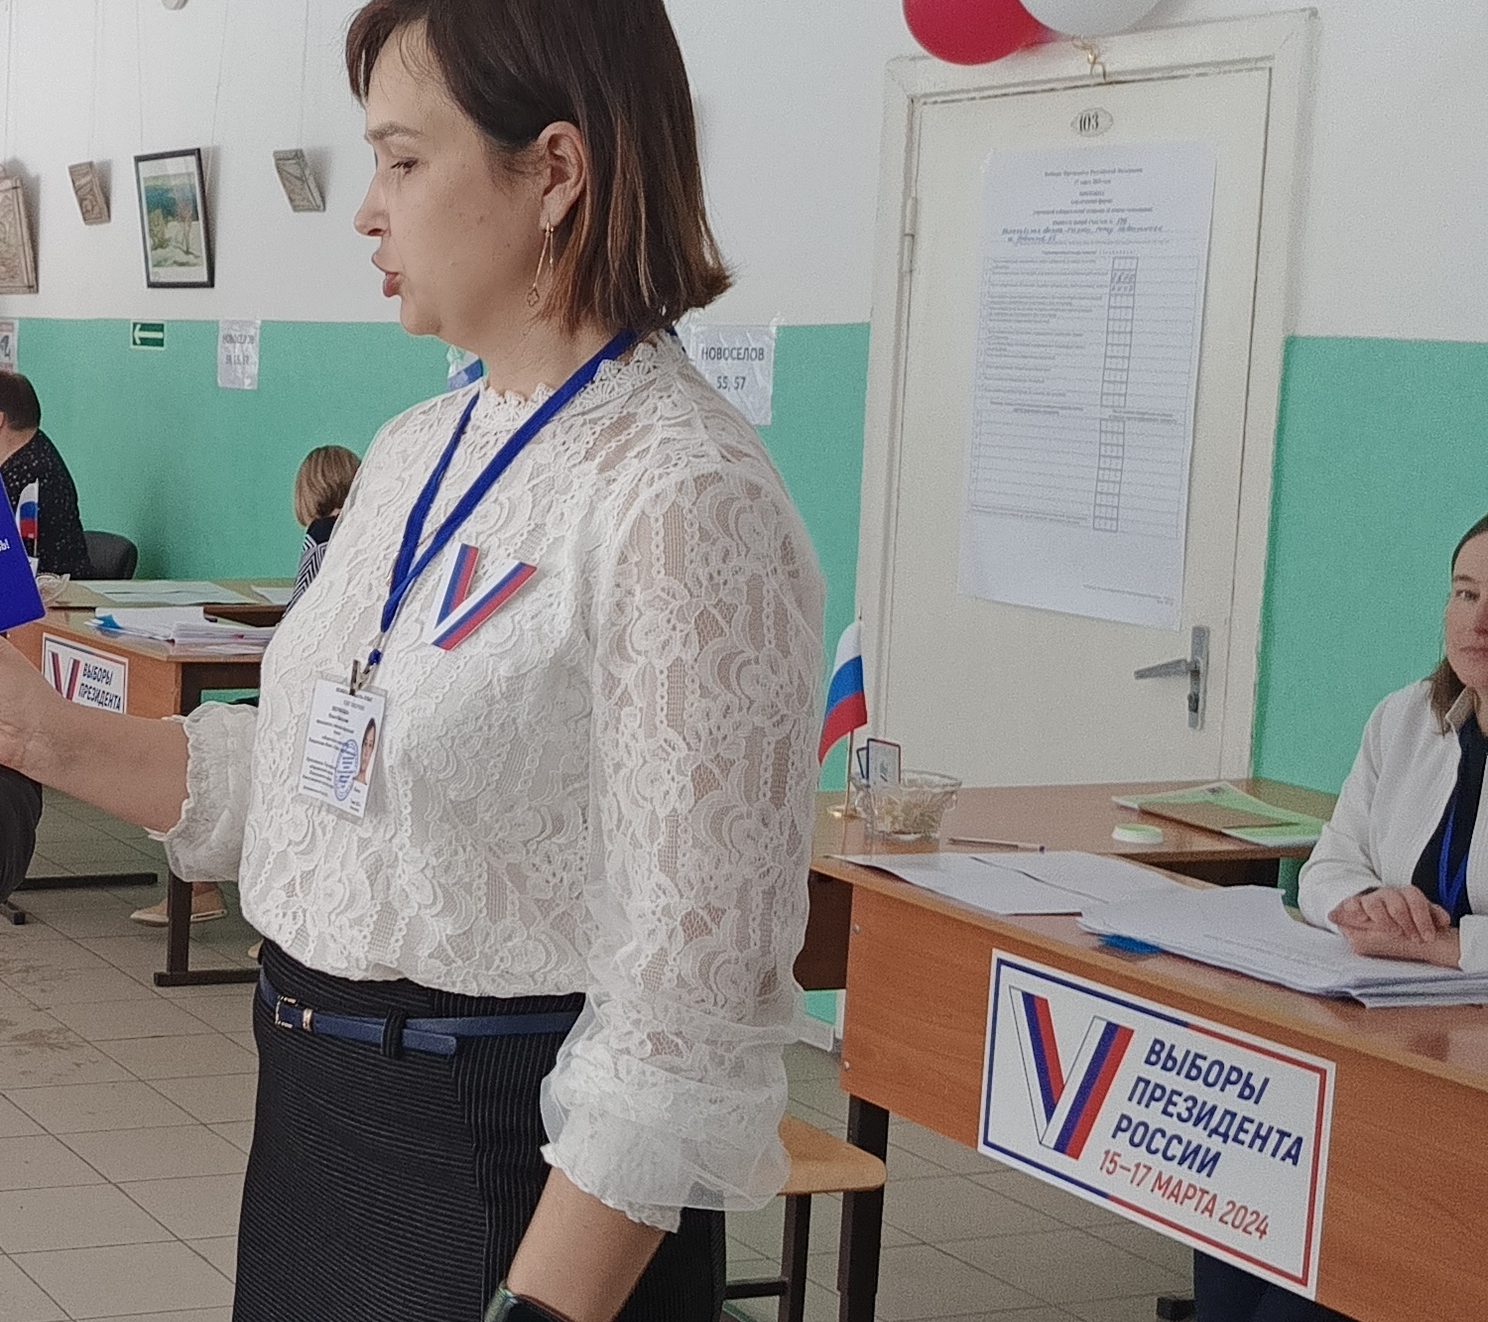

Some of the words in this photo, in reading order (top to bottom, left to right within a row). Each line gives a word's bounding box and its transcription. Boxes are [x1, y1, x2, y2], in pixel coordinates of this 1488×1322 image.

[1079, 111, 1099, 132] 103
[701, 347, 765, 361] НОВОСЕЛОВ
[716, 376, 731, 392] 55,
[733, 377, 746, 390] 57
[83, 662, 113, 686] ВЫБОРЫ
[78, 683, 121, 710] ПРЕЗИДЕНТА
[1144, 1037, 1270, 1104] ВЫБОРЫ
[1127, 1077, 1304, 1166] ПРЕЗИДЕНТА
[1111, 1114, 1222, 1178] РОССИИ
[1151, 1176, 1217, 1219] МАРТА
[1218, 1200, 1269, 1240] 2024
